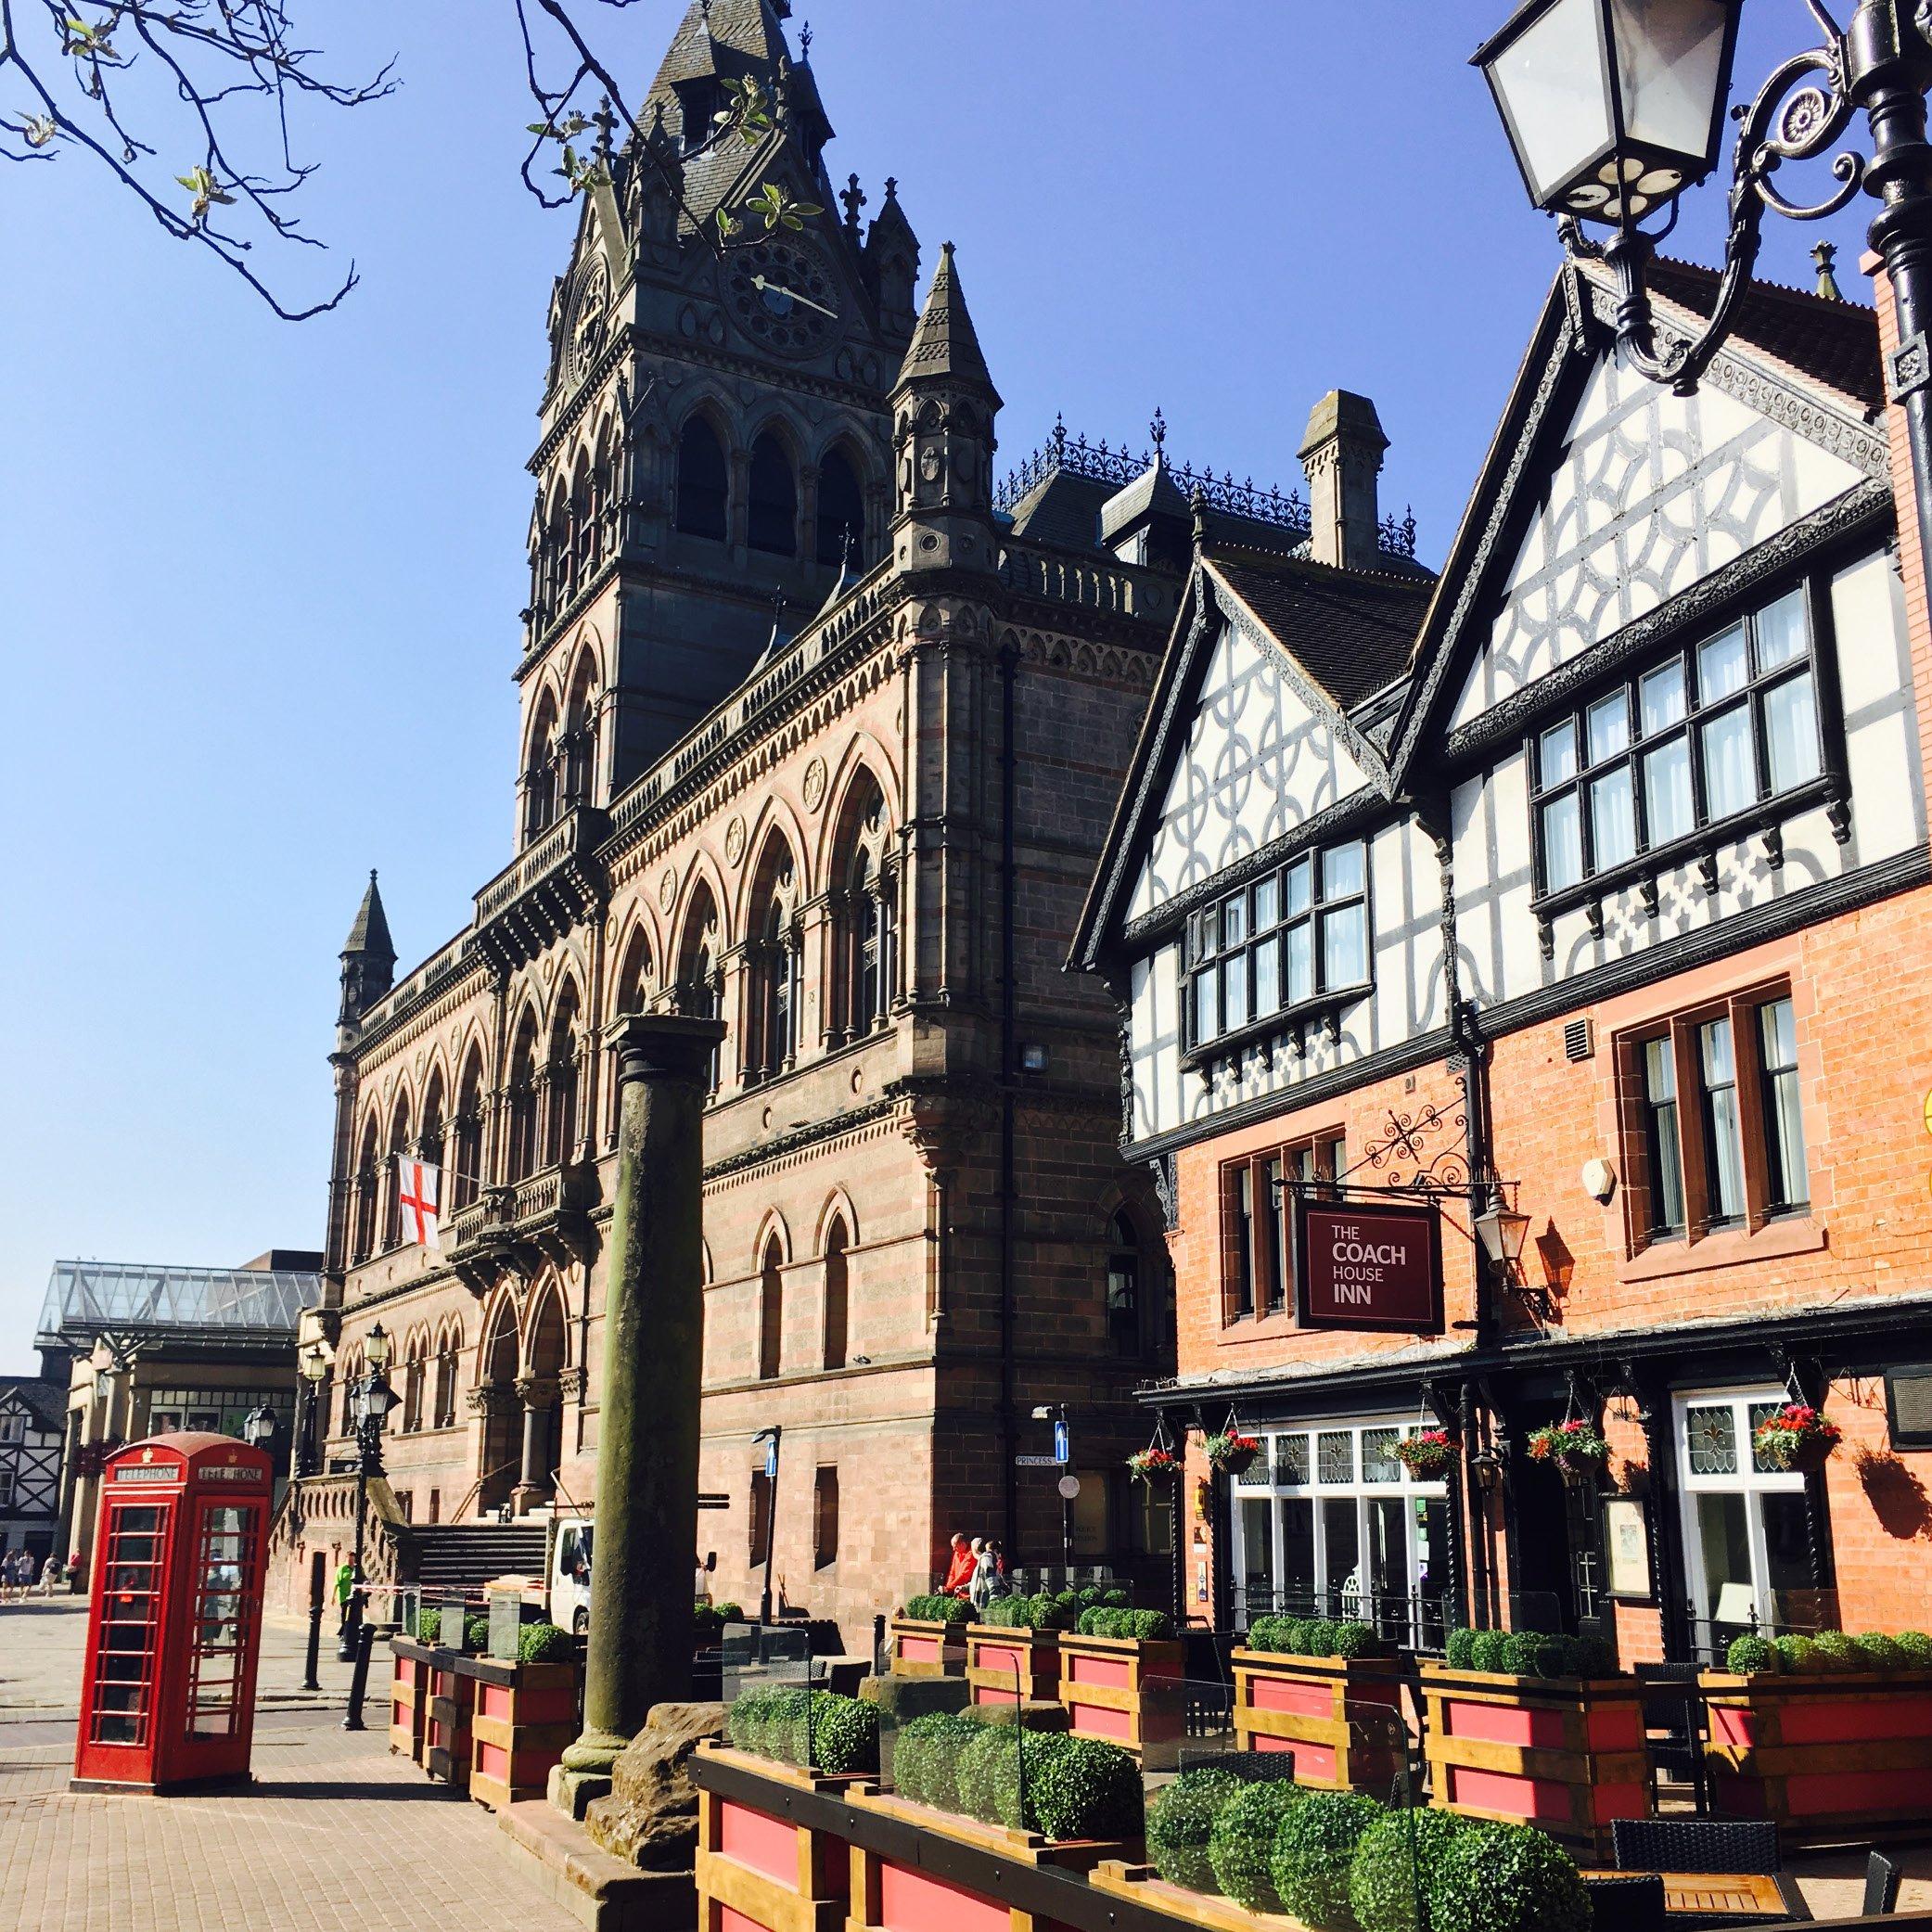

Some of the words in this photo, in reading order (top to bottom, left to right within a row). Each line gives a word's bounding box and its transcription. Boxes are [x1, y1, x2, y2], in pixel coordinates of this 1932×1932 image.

[1332, 1225, 1360, 1240] THE
[1333, 1243, 1405, 1265] COACH
[1334, 1266, 1383, 1282] HOUSE
[1335, 1284, 1371, 1305] INN
[119, 1468, 176, 1479] TELEPHONE
[201, 1467, 260, 1479] TELEHONE
